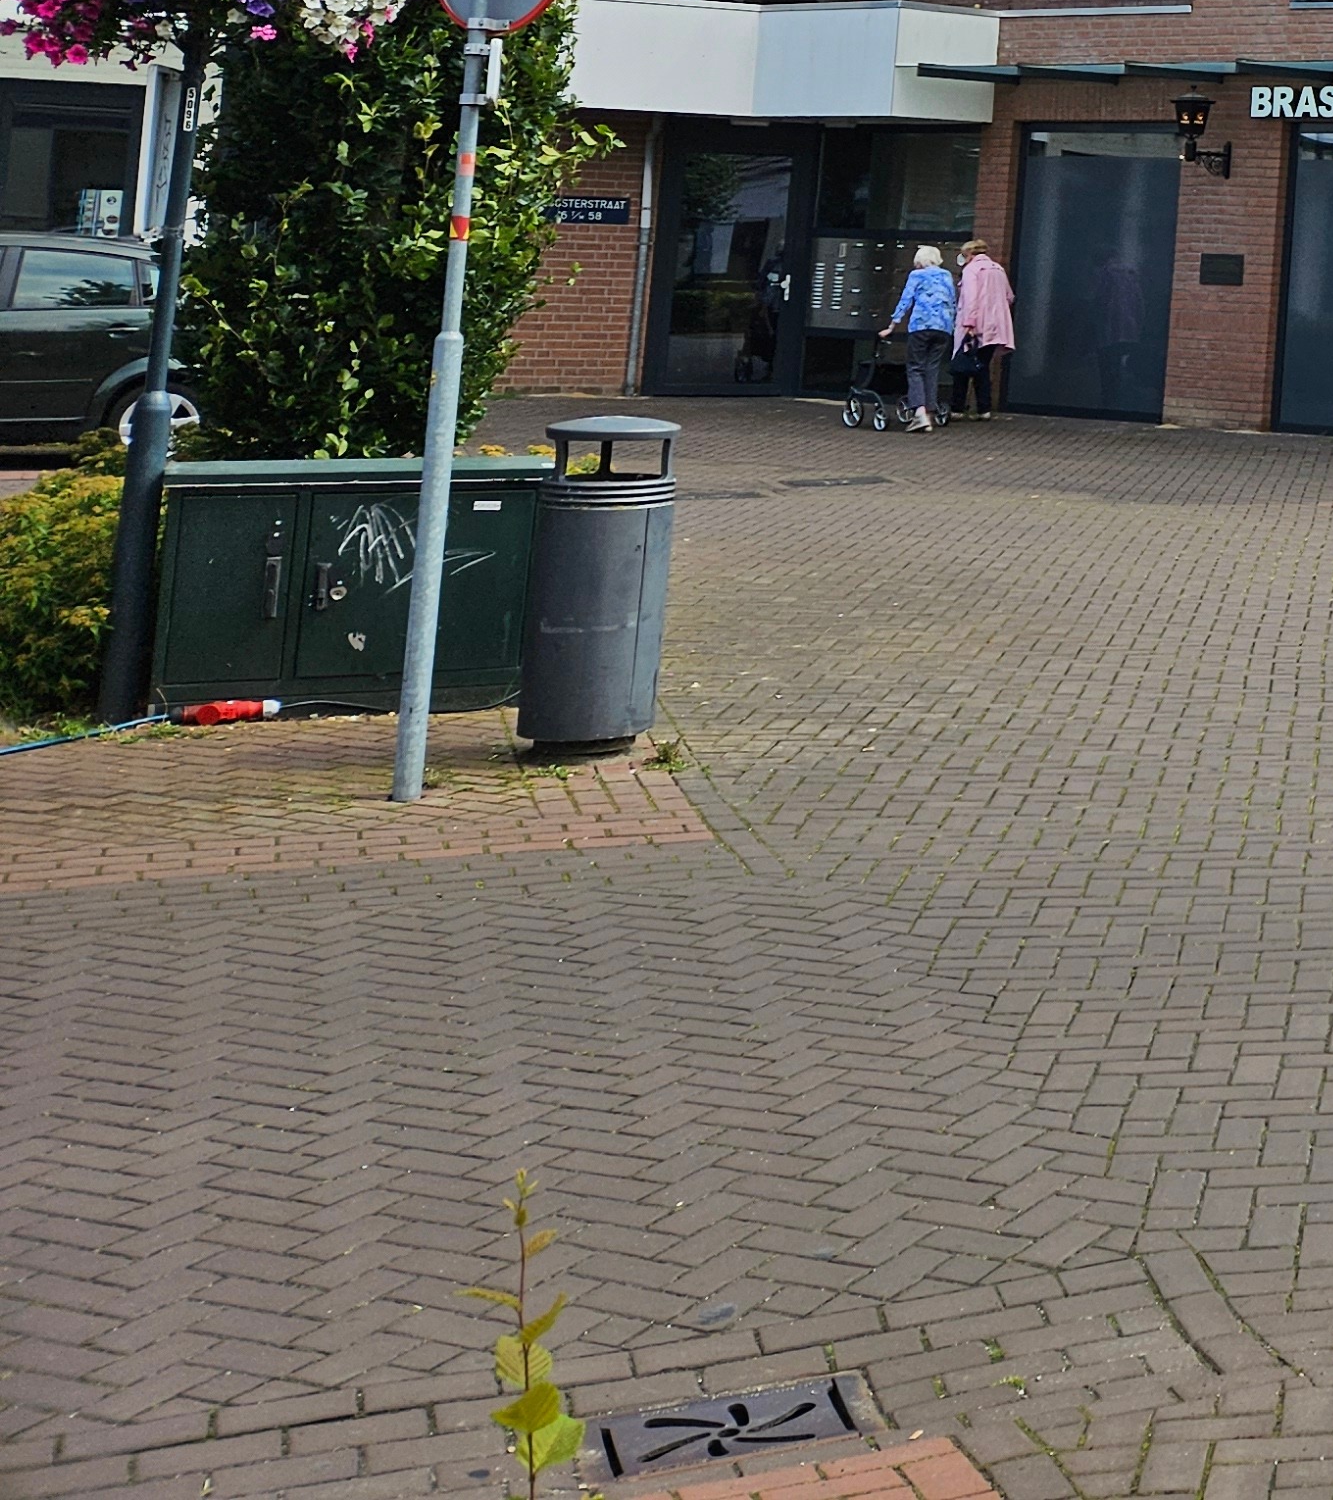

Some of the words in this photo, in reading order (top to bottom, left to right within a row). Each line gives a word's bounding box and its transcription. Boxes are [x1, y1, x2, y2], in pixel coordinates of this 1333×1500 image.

[185, 89, 195, 129] 5096
[549, 198, 626, 210] OSTERSTRAAT
[588, 211, 602, 221] 58
